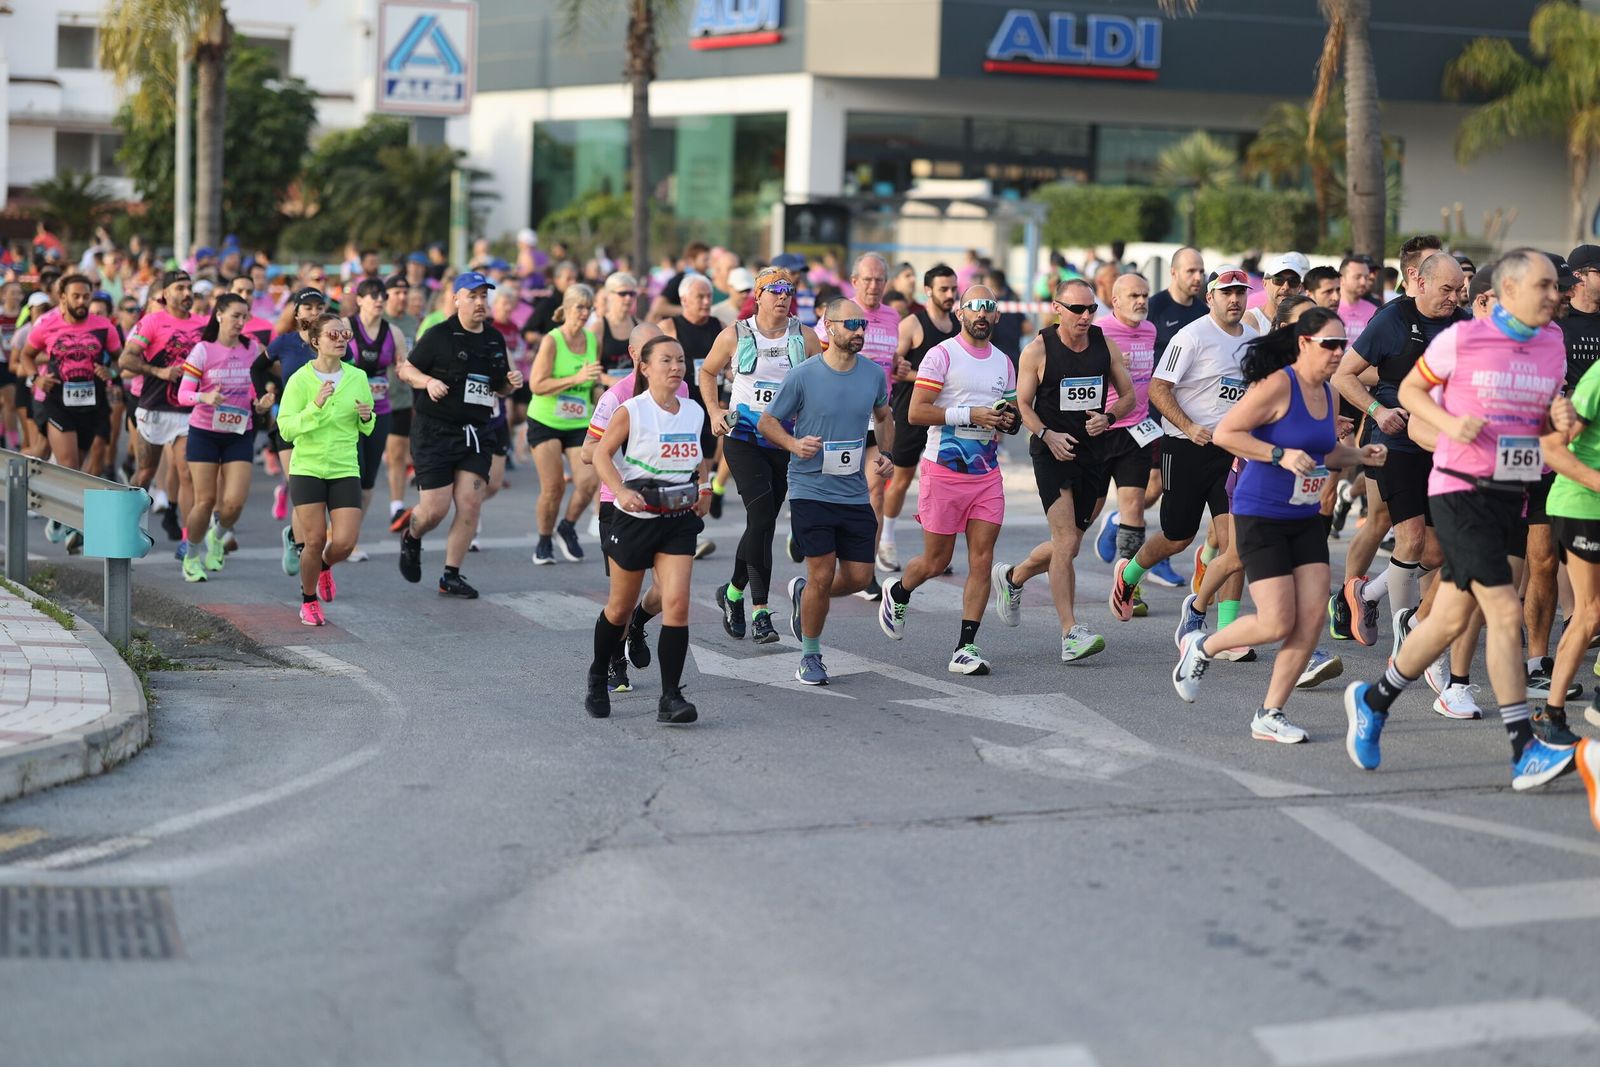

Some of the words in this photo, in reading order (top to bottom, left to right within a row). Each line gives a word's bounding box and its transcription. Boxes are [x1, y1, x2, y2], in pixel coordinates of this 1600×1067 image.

[986, 9, 1163, 69] ALDI
[387, 79, 462, 100] ALDI
[1471, 370, 1512, 388] MEDIA
[1067, 386, 1097, 401] 596
[561, 402, 584, 415] 550
[219, 412, 242, 424] 820
[661, 443, 698, 458] 2435
[840, 451, 851, 465] 6
[1501, 449, 1541, 466] 1561
